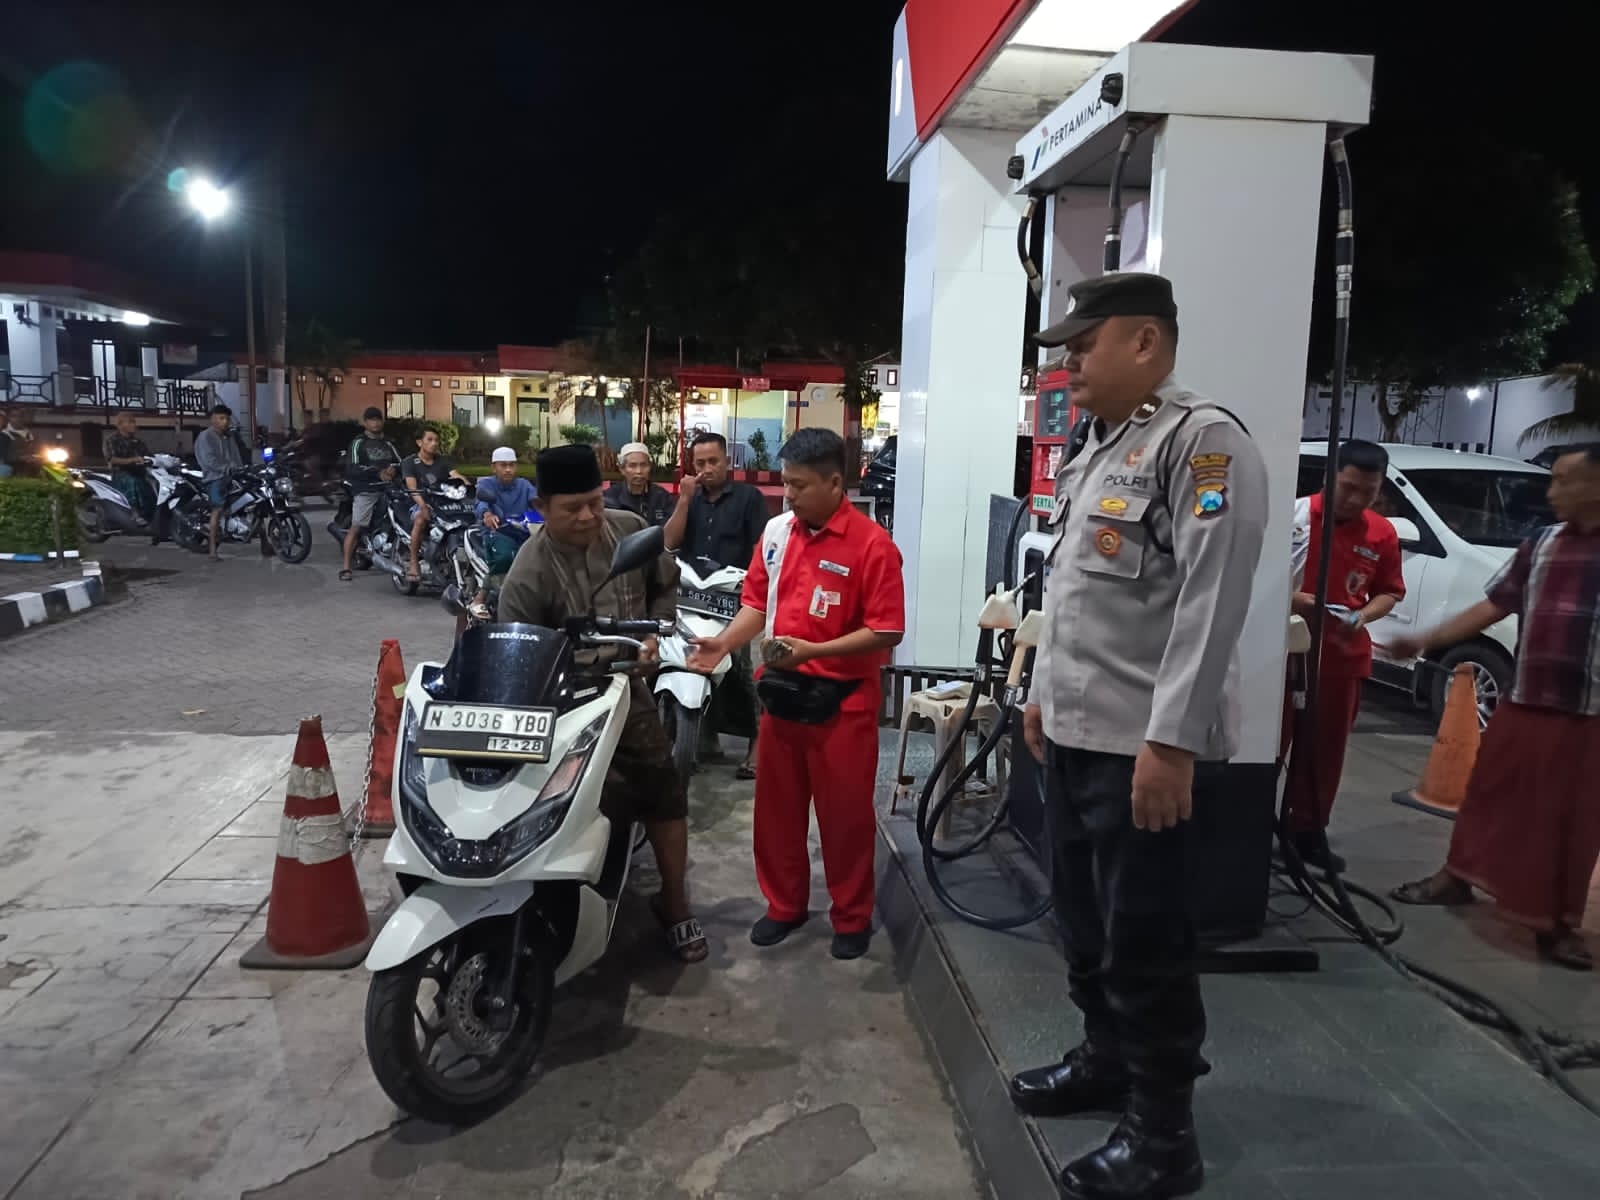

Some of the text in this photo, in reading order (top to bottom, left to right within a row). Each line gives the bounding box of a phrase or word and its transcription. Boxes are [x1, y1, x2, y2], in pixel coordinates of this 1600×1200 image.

[1049, 97, 1102, 150] PERTAMINA
[1103, 474, 1149, 489] POLRI
[488, 632, 540, 642] HONDA
[430, 710, 443, 727] N
[452, 711, 504, 730] 3036
